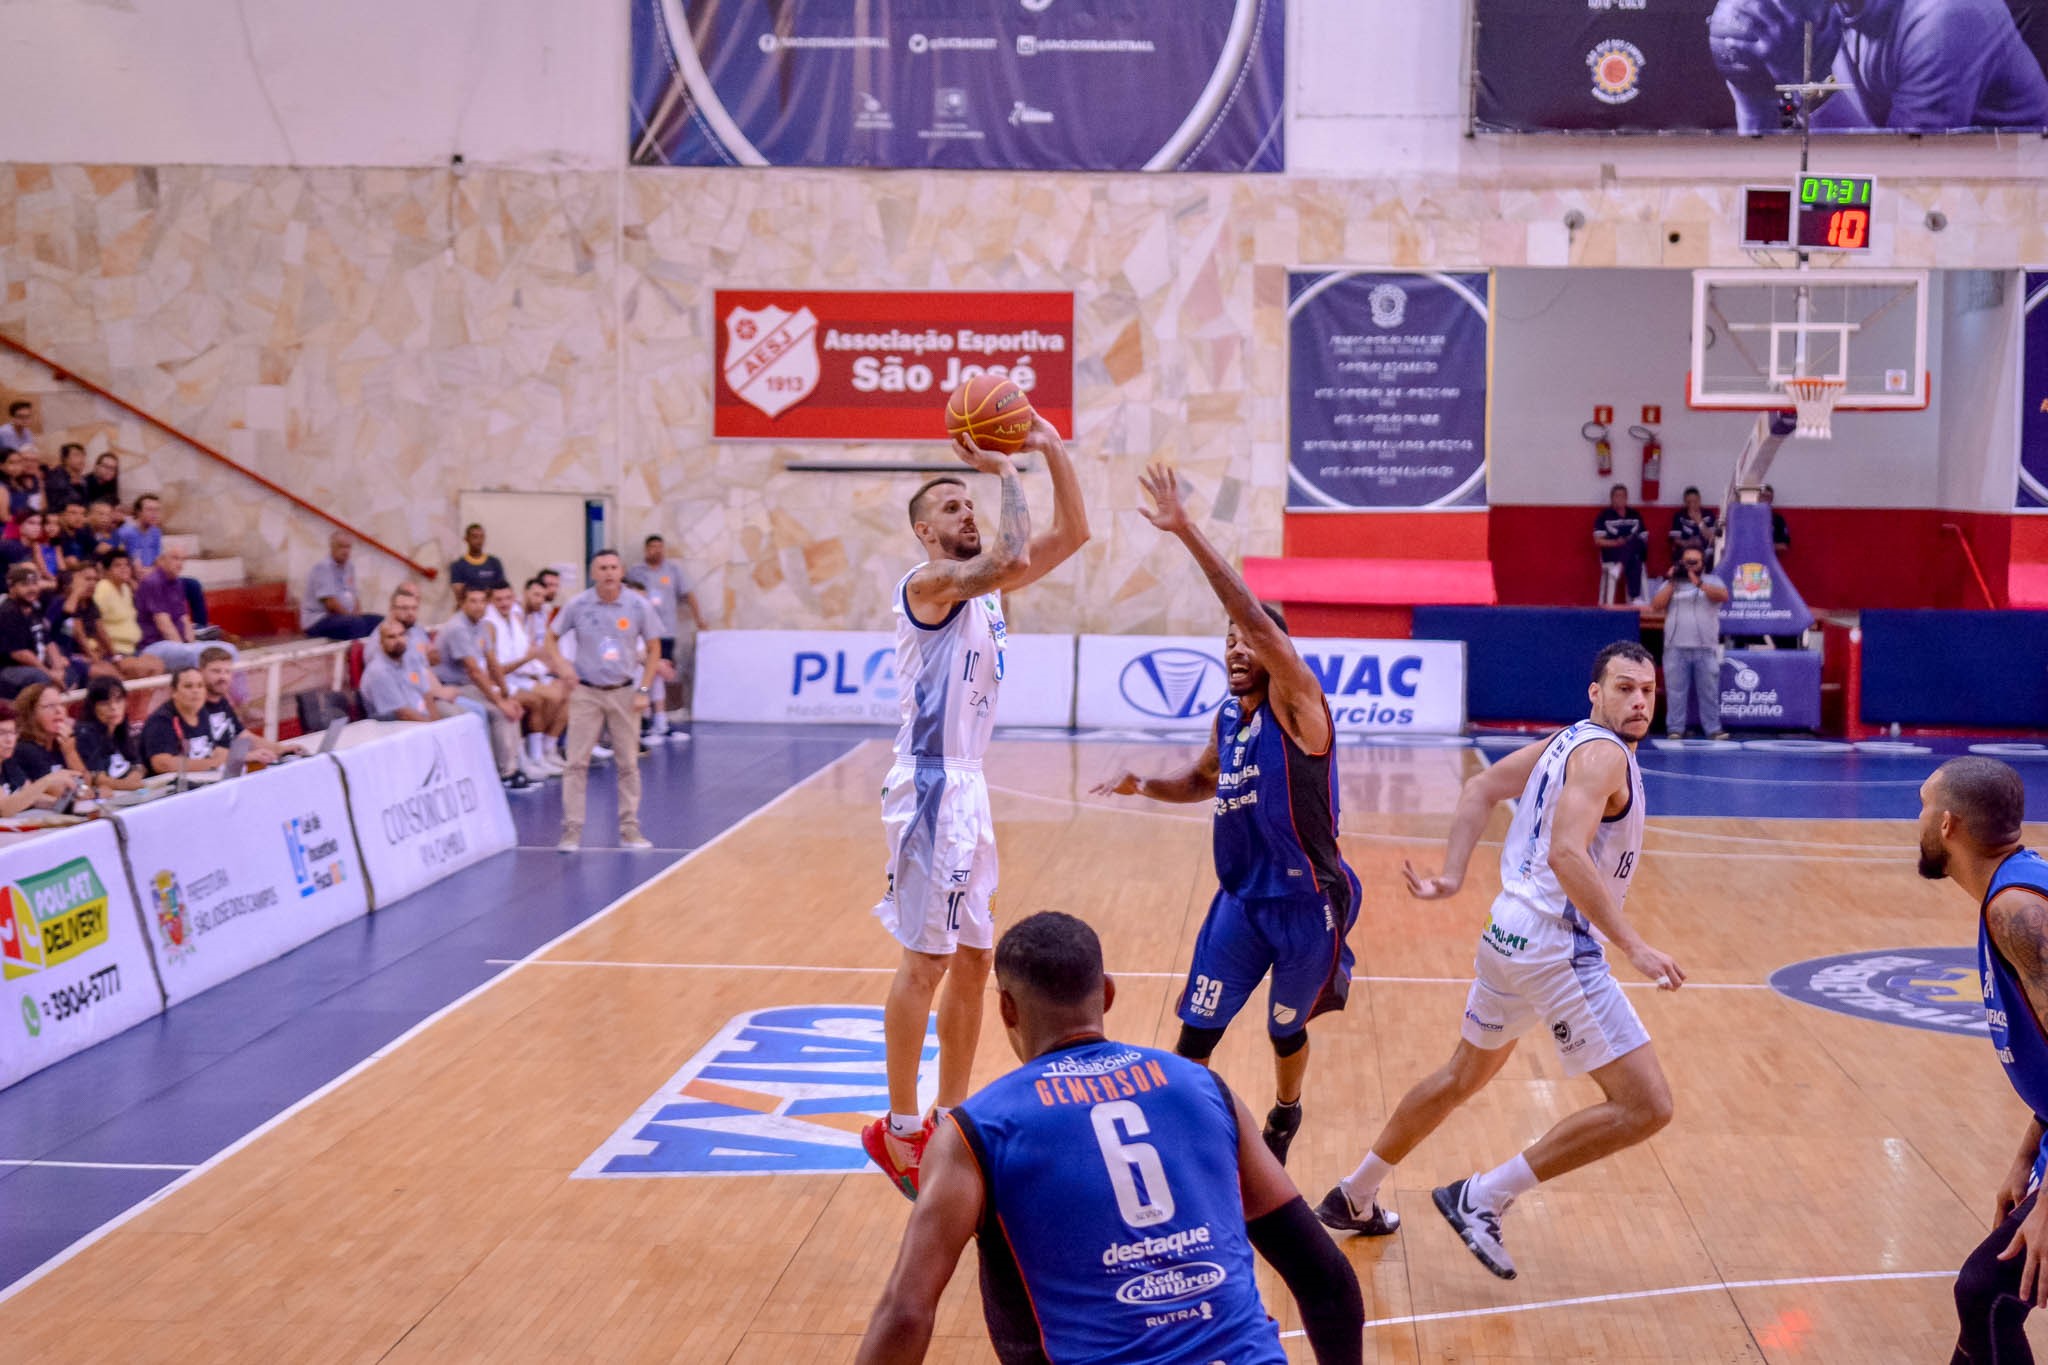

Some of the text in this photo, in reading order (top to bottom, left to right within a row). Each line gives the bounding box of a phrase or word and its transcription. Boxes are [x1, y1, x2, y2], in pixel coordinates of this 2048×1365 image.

[1801, 178, 1870, 204] 07:31
[1827, 210, 1868, 249] 10
[823, 329, 1065, 355] Associação Esportiva
[767, 376, 803, 392] 1913
[852, 357, 933, 392] São
[1613, 851, 1634, 879] 18
[43, 903, 103, 954] DELIVERY
[50, 963, 121, 1021] 3904-5777
[1191, 974, 1223, 1010] 33
[1034, 1059, 1168, 1106] GEMERSON
[1090, 1099, 1176, 1228] 6
[1102, 1226, 1210, 1266] destaque
[1127, 1271, 1219, 1300] Compras
[1143, 1269, 1184, 1288] Rede
[1145, 1308, 1200, 1328] RUTRA
